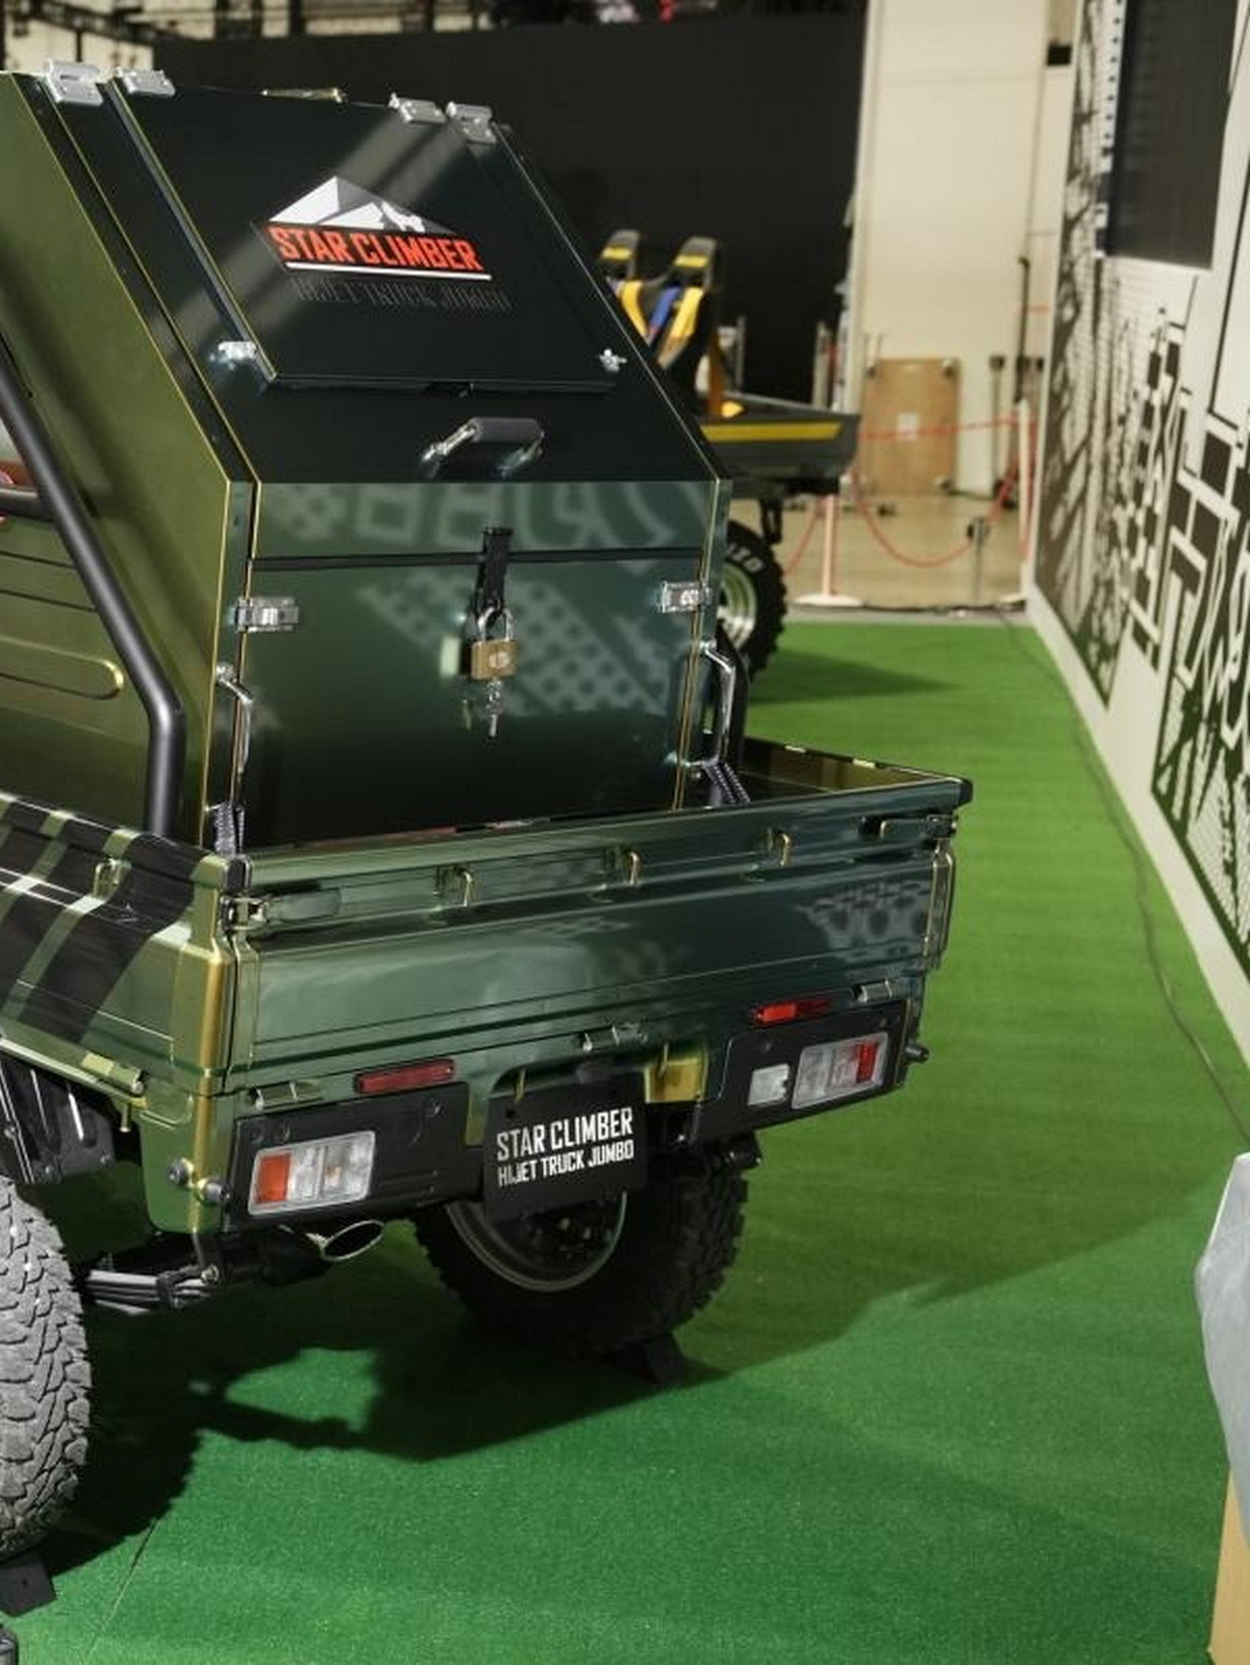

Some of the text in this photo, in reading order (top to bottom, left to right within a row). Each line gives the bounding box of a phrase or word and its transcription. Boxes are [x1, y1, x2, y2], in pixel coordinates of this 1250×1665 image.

[267, 226, 485, 271] STAR CLIMBER
[496, 1106, 634, 1162] STAR CLIMBER
[497, 1138, 635, 1188] HIJET TRUCK JUMBO
